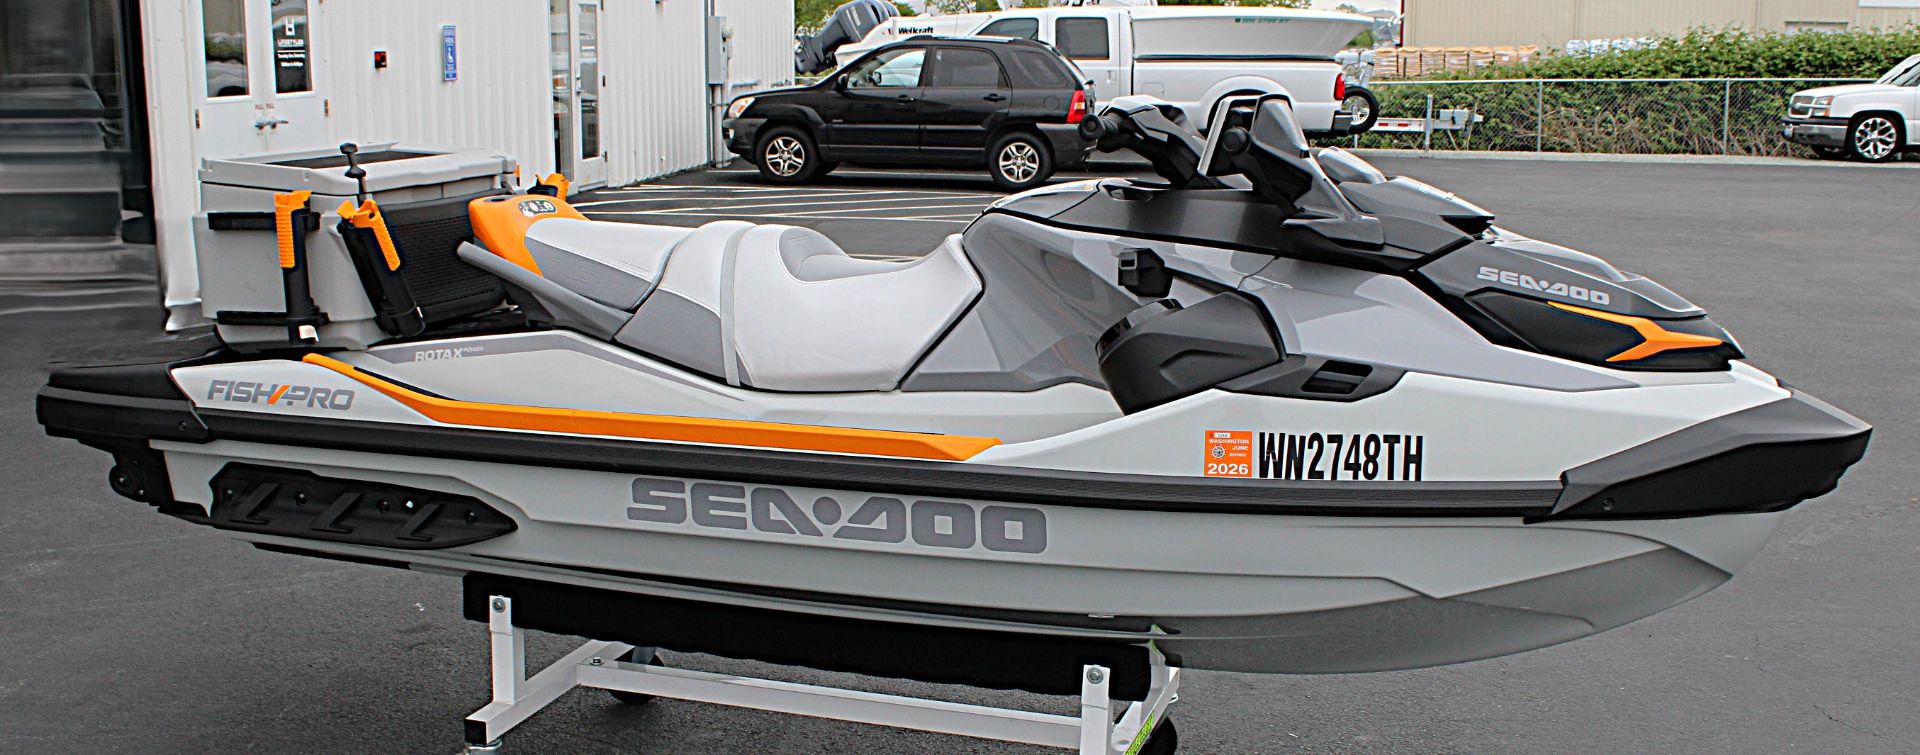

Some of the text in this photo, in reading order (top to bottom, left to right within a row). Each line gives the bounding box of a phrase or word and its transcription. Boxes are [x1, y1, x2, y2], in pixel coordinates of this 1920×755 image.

[415, 347, 464, 363] ROTAX
[1258, 431, 1424, 482] WN2748TH
[1207, 463, 1249, 475] 2026
